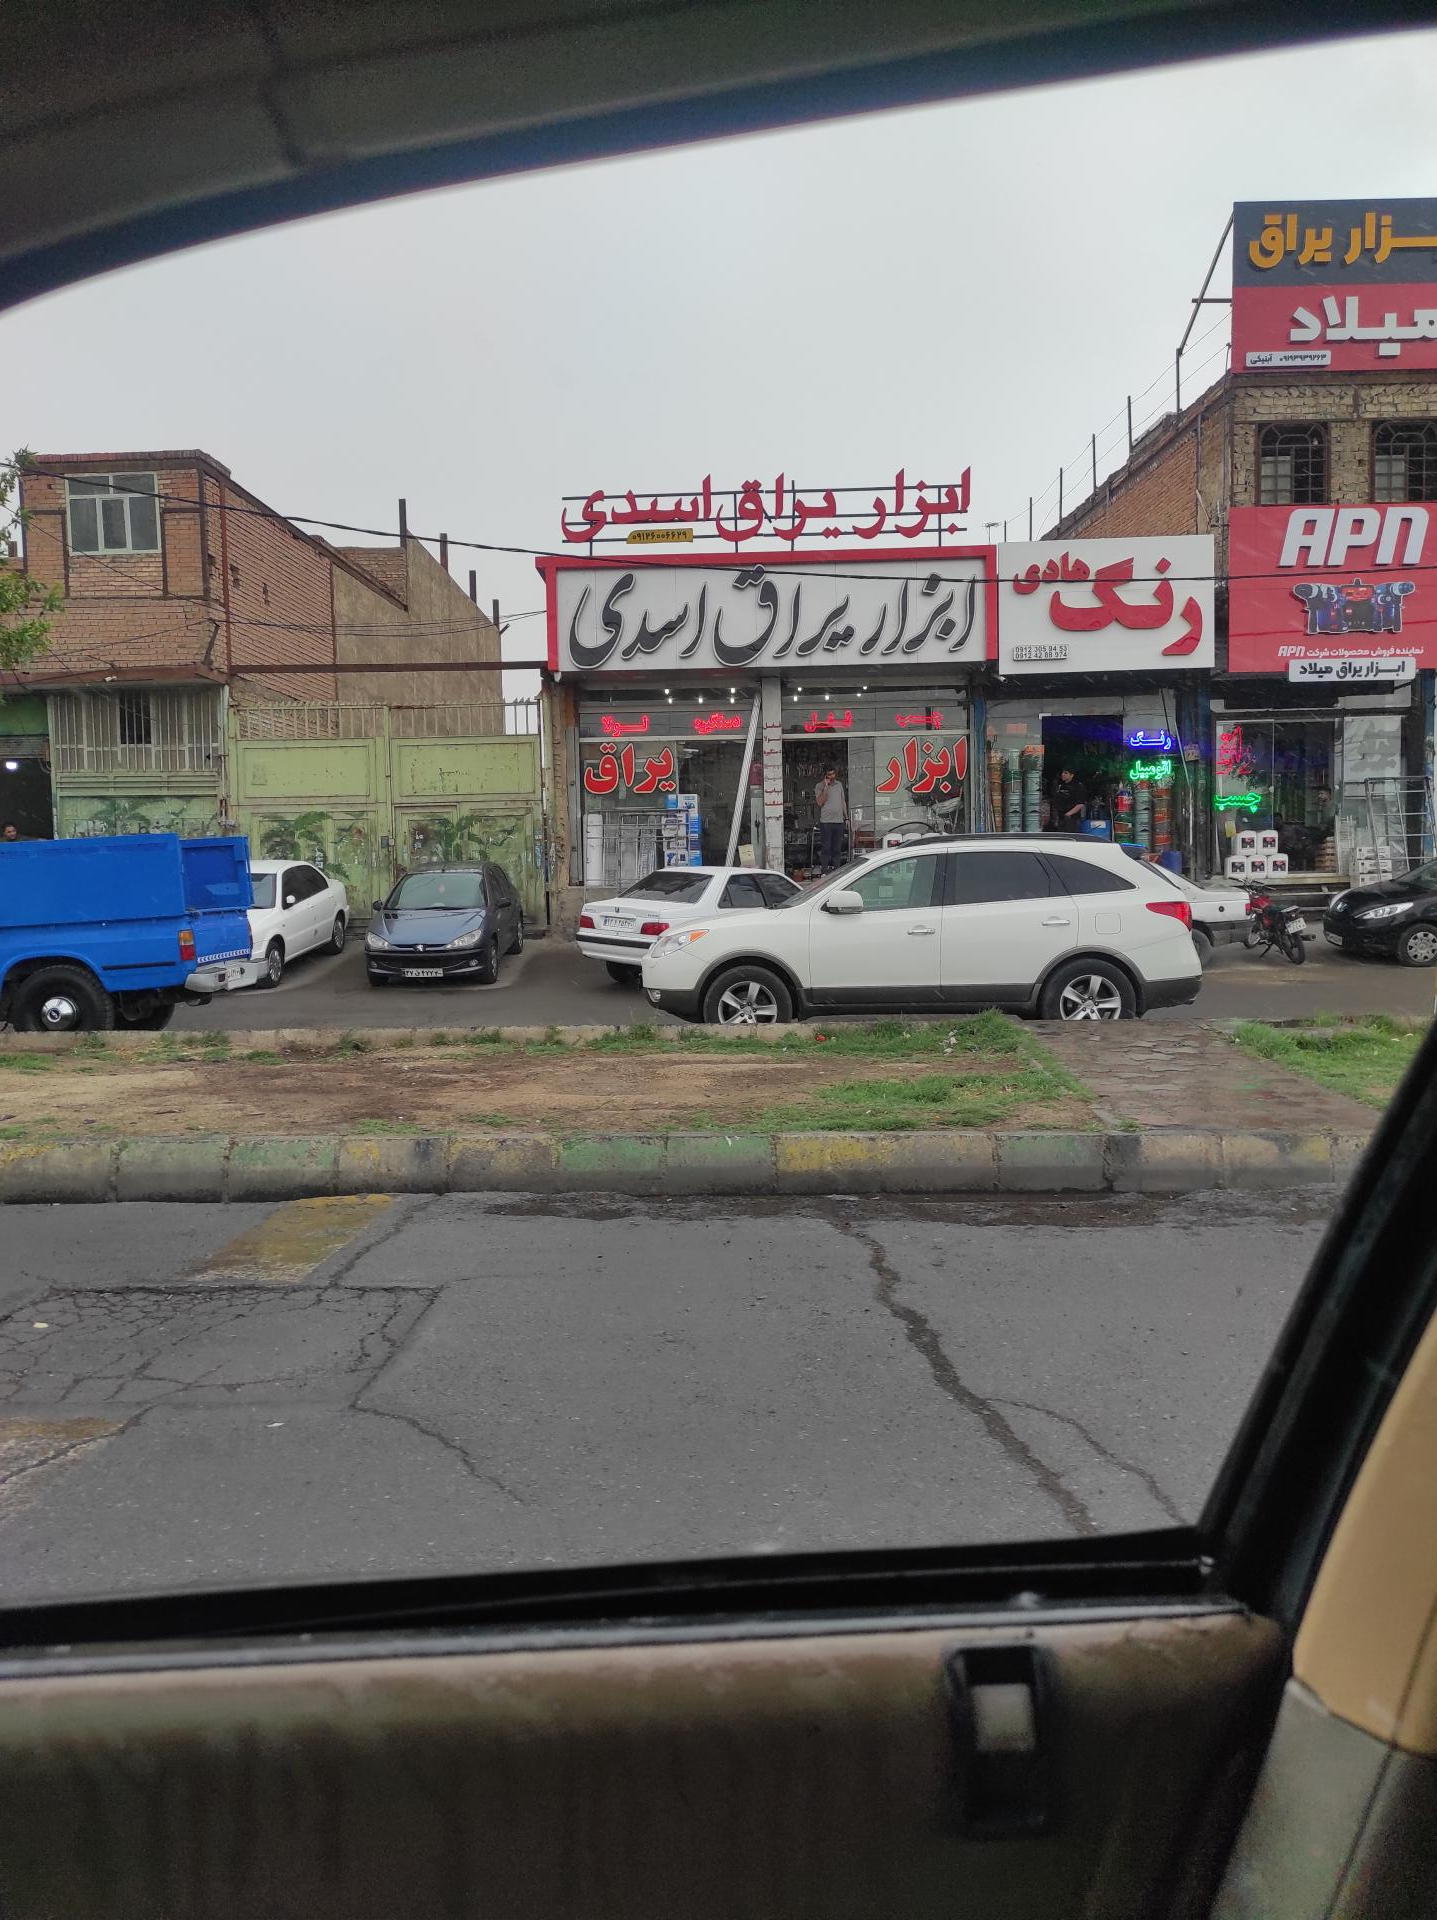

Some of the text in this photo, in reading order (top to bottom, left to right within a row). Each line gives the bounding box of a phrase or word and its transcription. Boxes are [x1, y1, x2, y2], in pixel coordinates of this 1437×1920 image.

[1249, 211, 1437, 269] زار یراق
[561, 465, 971, 543] ابزار یراق اسدی
[1278, 506, 1430, 567] APN
[568, 564, 977, 669] ابزار یراق اسدی
[1012, 551, 1203, 656] رنگ هادی
[1278, 645, 1424, 658] نماینده فروش محصولات شرکت APN
[1299, 661, 1406, 679] ابزار یراق میلاد
[601, 714, 649, 737] لولا
[1129, 730, 1173, 750] رنگ
[584, 742, 677, 795] یراق
[876, 735, 968, 794] ابزار
[1129, 759, 1172, 780] اتومبیل
[1215, 792, 1262, 813] چسب
